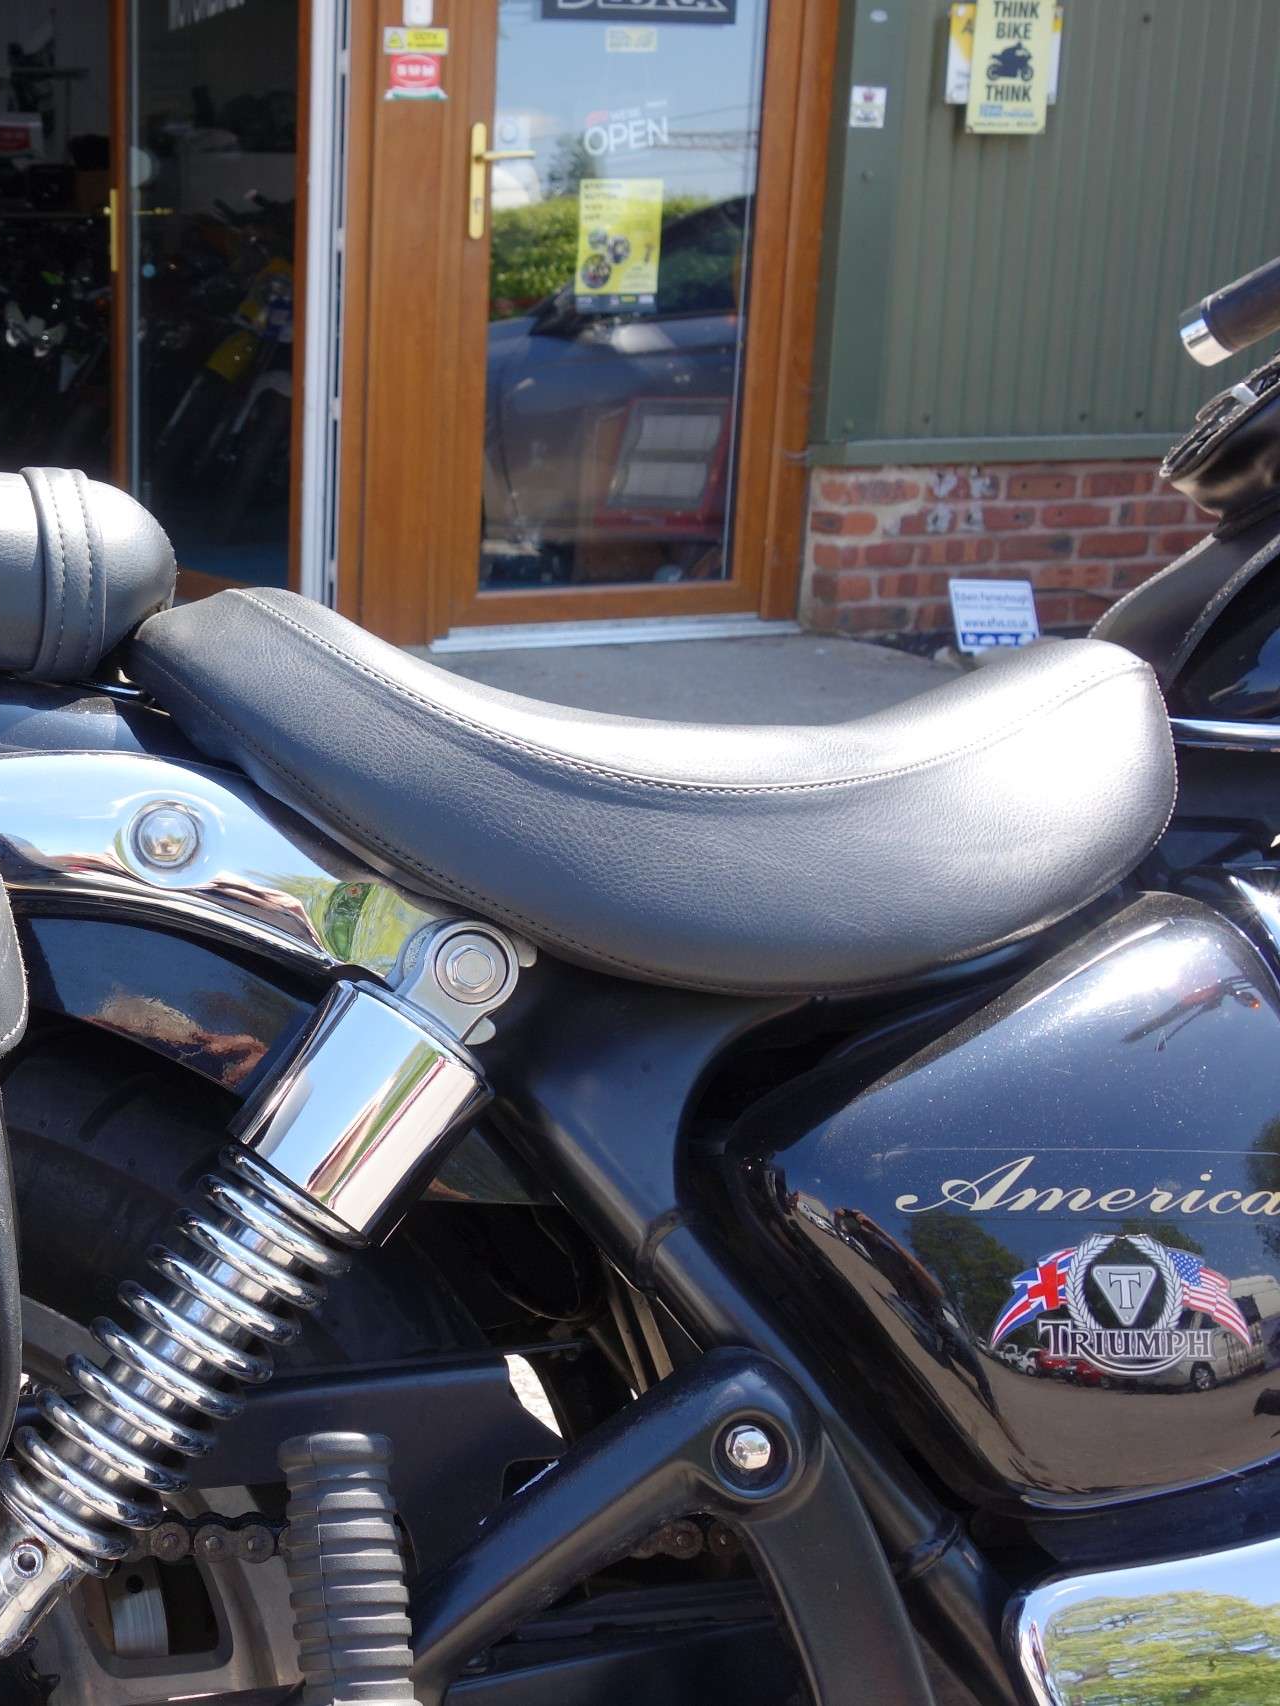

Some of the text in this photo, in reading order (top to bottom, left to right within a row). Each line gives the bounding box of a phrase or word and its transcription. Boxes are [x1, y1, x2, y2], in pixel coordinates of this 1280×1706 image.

[994, 1, 1040, 19] THINK
[996, 22, 1032, 39] BIKE
[985, 84, 1032, 102] THINK
[584, 116, 669, 156] OPEN
[895, 1155, 1280, 1214] America
[1108, 1272, 1142, 1310] T
[1037, 1319, 1216, 1360] TRIUMPH
